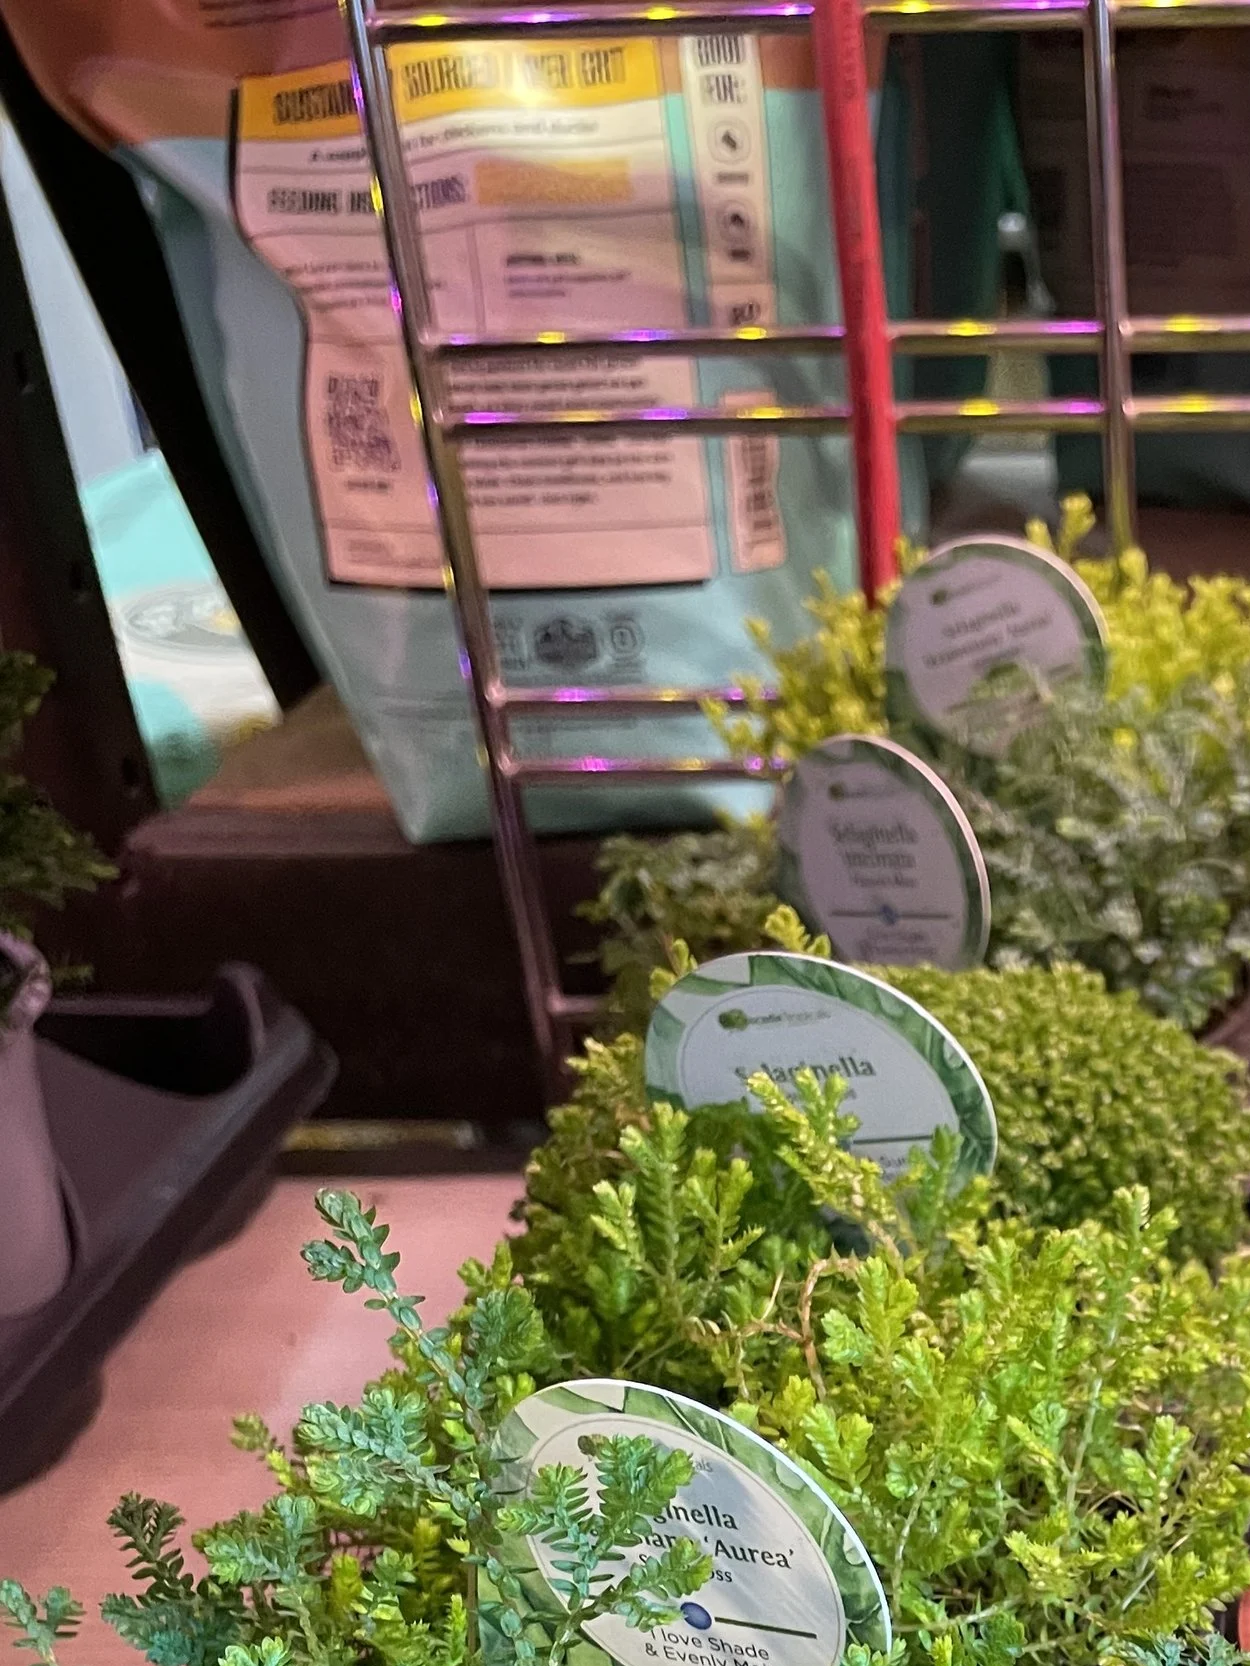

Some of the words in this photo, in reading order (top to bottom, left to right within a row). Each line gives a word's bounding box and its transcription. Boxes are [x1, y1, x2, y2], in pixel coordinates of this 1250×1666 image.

[645, 1643, 659, 1657] &
[661, 1628, 702, 1648] love
[707, 1636, 769, 1661] Shade
